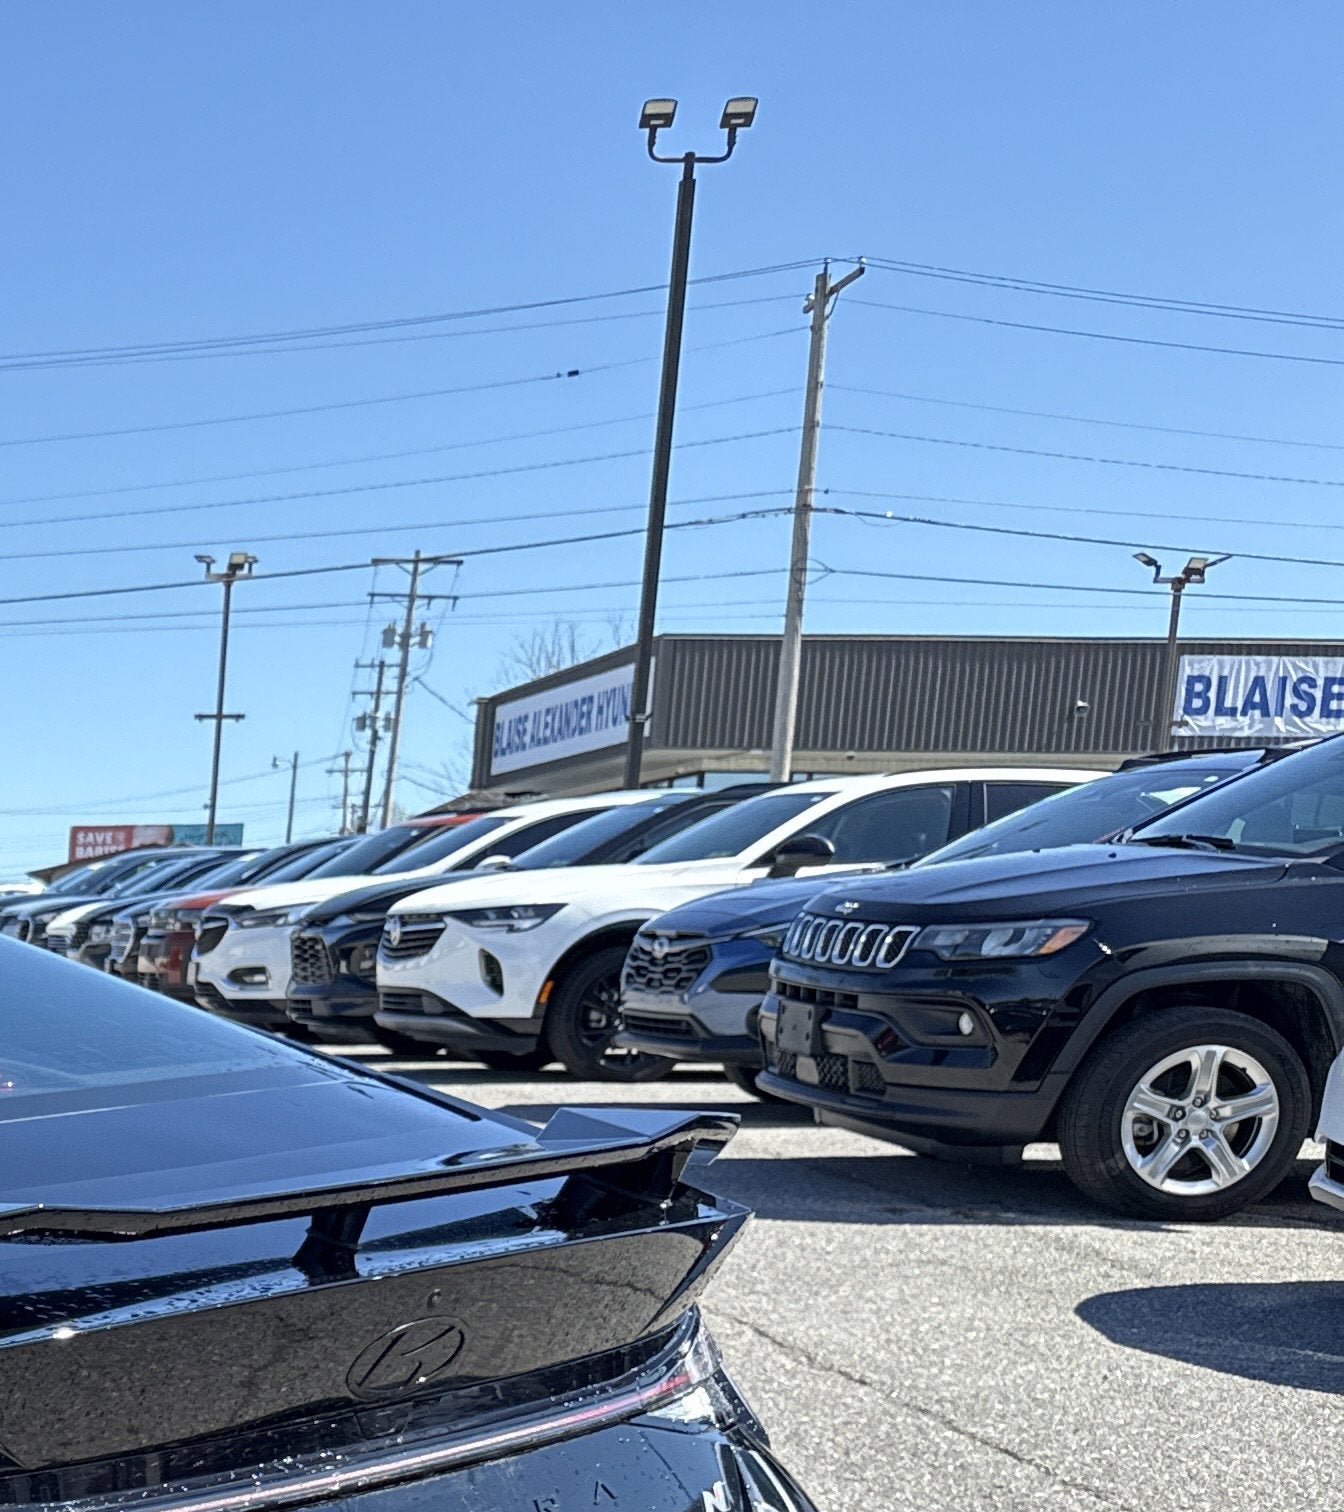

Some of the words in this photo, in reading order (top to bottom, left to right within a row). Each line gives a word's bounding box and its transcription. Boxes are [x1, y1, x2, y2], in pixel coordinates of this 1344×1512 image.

[1183, 675, 1344, 718] BLAISE
[493, 712, 529, 758] BLAISE
[528, 695, 594, 750] ALEXANDER
[595, 683, 632, 732] HYUN
[76, 831, 112, 846] SAVE
